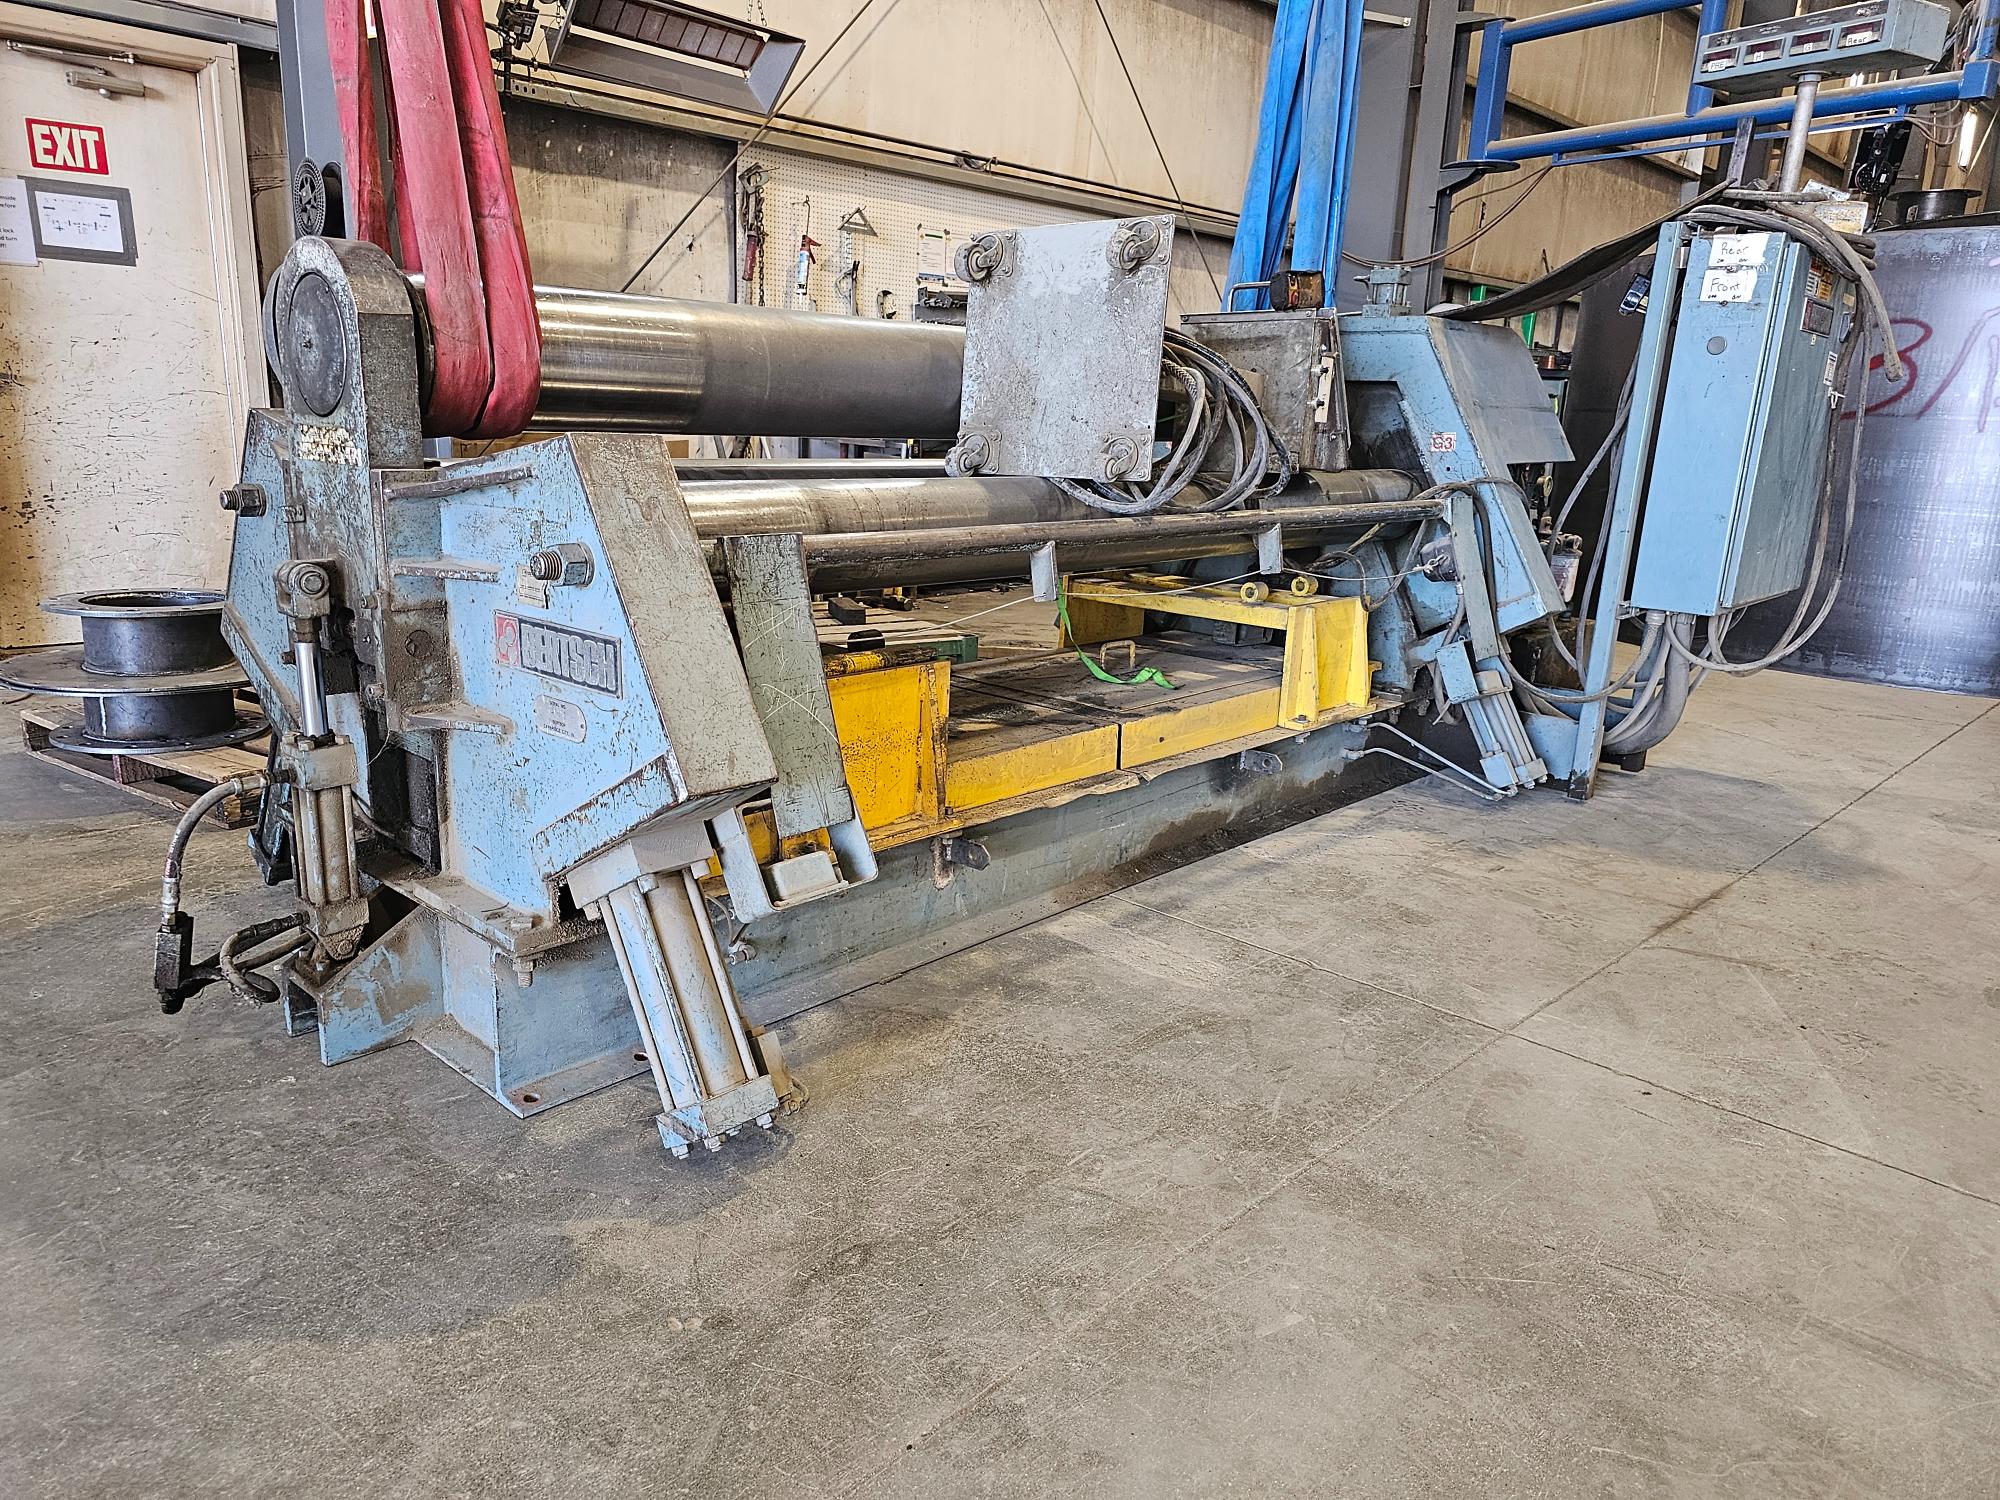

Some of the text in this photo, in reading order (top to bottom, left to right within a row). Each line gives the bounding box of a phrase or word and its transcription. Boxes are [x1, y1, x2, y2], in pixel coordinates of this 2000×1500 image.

[31, 123, 100, 170] EXIT
[1721, 241, 1749, 255] Rear
[1710, 277, 1741, 292] Front
[1432, 436, 1453, 450] G3
[521, 622, 617, 691] BERTSCH
